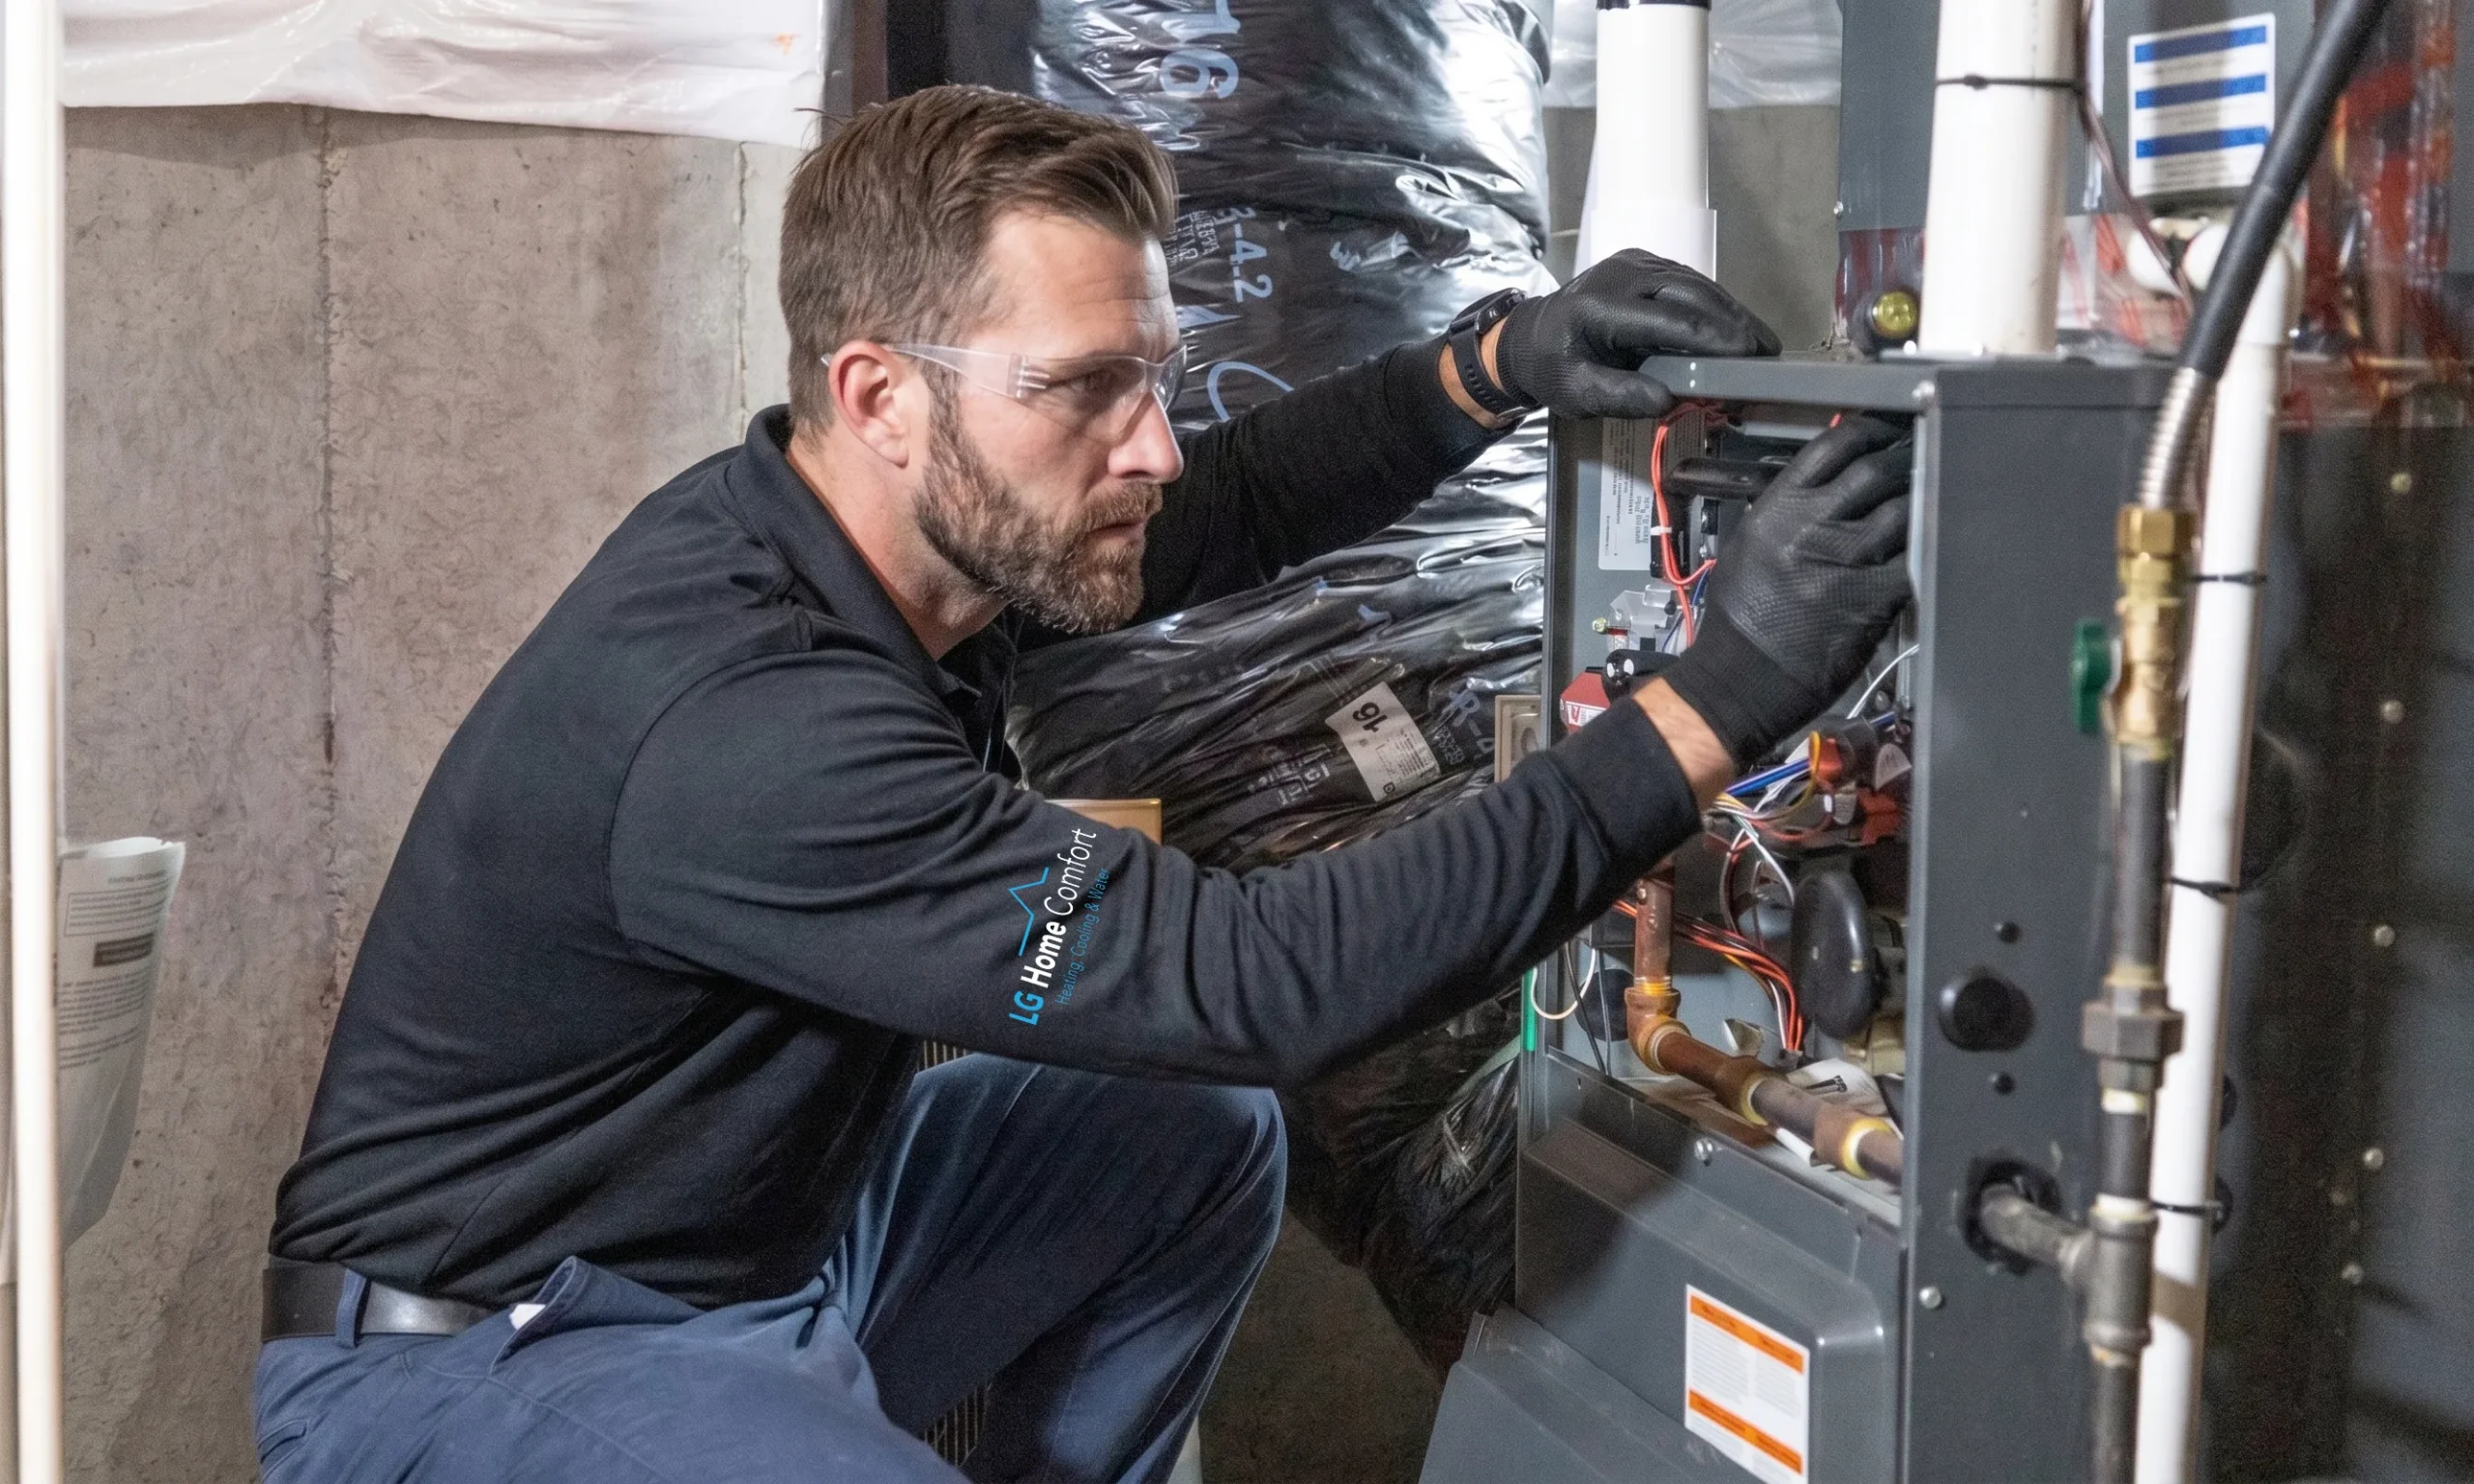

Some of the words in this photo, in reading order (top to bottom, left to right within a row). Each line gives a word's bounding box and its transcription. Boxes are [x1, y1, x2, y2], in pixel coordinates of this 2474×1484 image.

[1044, 828, 1097, 917] Comfort
[1087, 868, 1111, 900] Water
[1084, 902, 1100, 912] &
[1020, 921, 1067, 988] Home
[1071, 914, 1100, 956] Cooling
[1055, 960, 1085, 1006] Heating,
[1008, 989, 1045, 1026] LG
